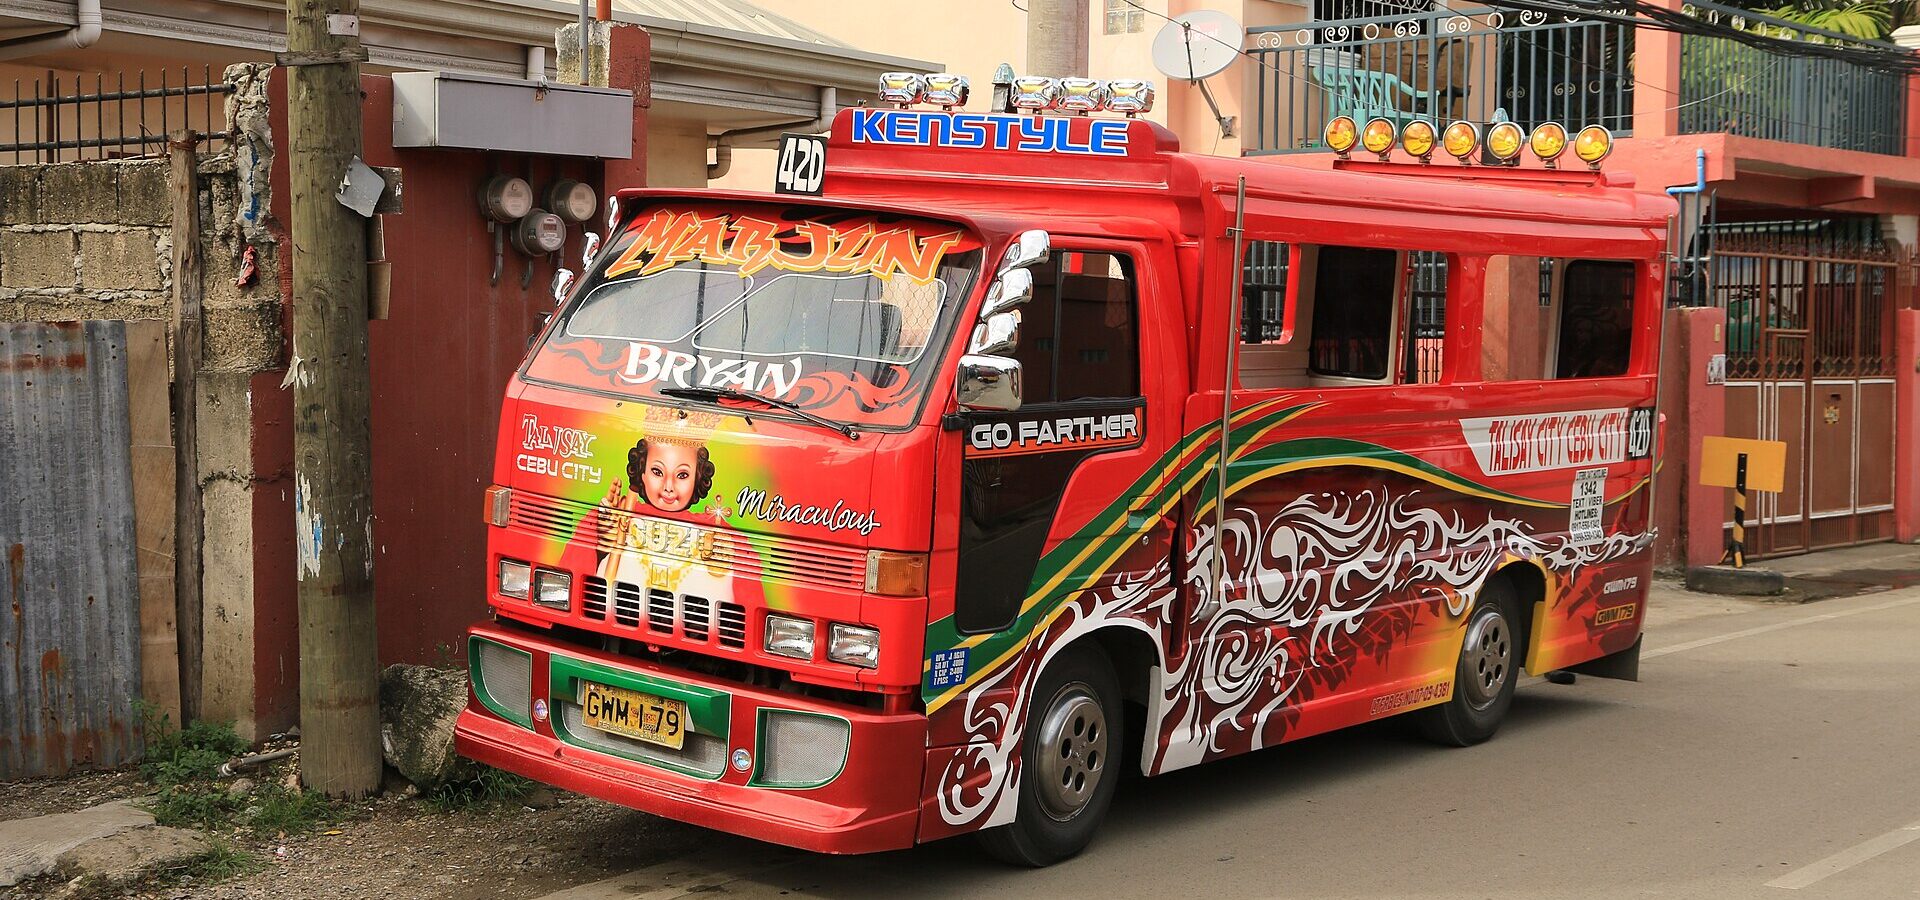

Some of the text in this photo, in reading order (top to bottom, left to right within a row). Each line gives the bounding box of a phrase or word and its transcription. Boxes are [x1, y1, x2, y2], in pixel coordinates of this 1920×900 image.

[851, 110, 1130, 156] KENSTYLE
[778, 137, 825, 193] 42D
[605, 209, 963, 286] MARJUN
[616, 341, 802, 398] BRYAN
[521, 413, 598, 458] TALISAY
[971, 413, 1138, 449] GO FARTHER
[1489, 411, 1626, 471] TALISAY CITY CEBU CITY
[1628, 409, 1651, 457] 42D
[516, 453, 602, 484] CEBU CITY
[1580, 481, 1597, 496] 1342
[736, 486, 881, 536] Miraculous
[1573, 497, 1585, 509] TEXT
[1588, 495, 1602, 507] VIBER
[587, 691, 630, 726] GWM
[639, 703, 680, 737] 179
